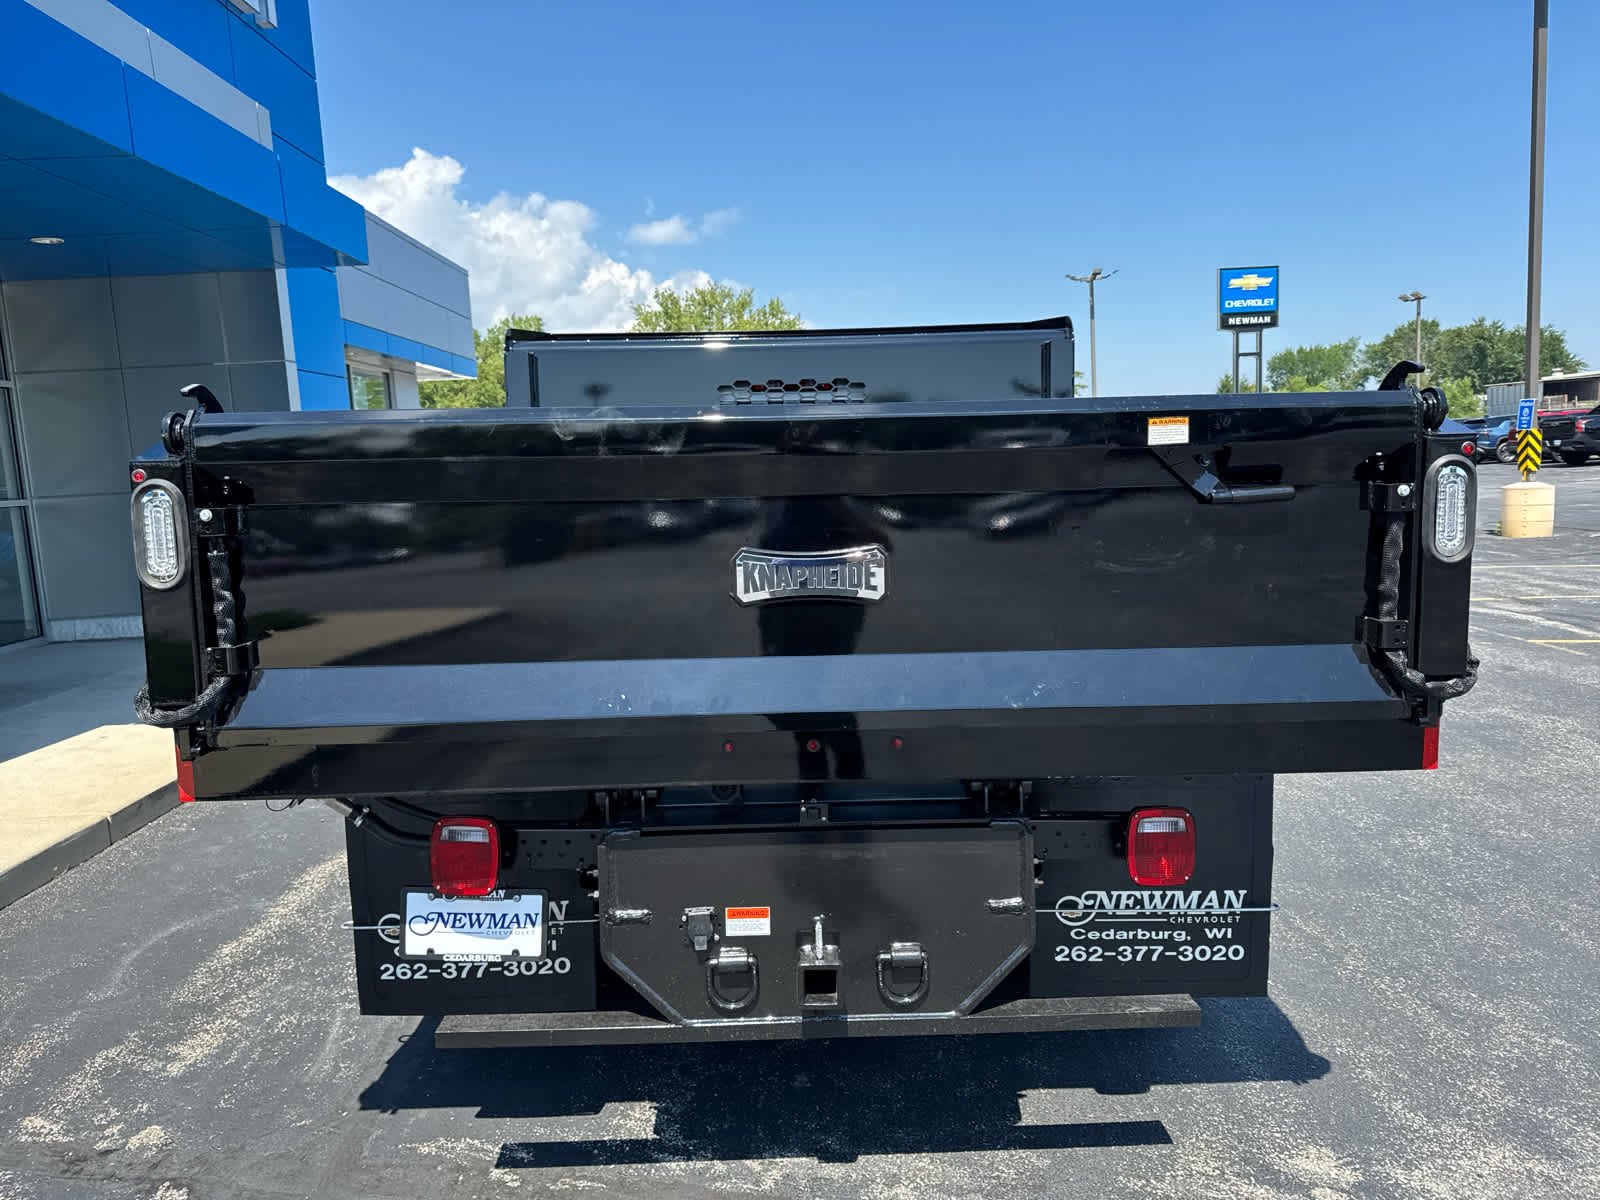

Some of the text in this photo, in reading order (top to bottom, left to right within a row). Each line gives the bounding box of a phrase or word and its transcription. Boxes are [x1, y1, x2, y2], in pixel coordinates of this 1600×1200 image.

[1225, 298, 1274, 308] CHEVROLET
[1228, 316, 1271, 325] NEWMAN
[743, 560, 878, 594] KNAPHEIDE
[1081, 890, 1247, 914] NEWMAN
[409, 911, 539, 935] NEWMAN
[1070, 928, 1233, 941] Cedarburg, WI
[442, 954, 502, 962] CEDARBURG
[1054, 945, 1245, 961] 262-377-3020
[380, 957, 571, 980] 262-377-3020
